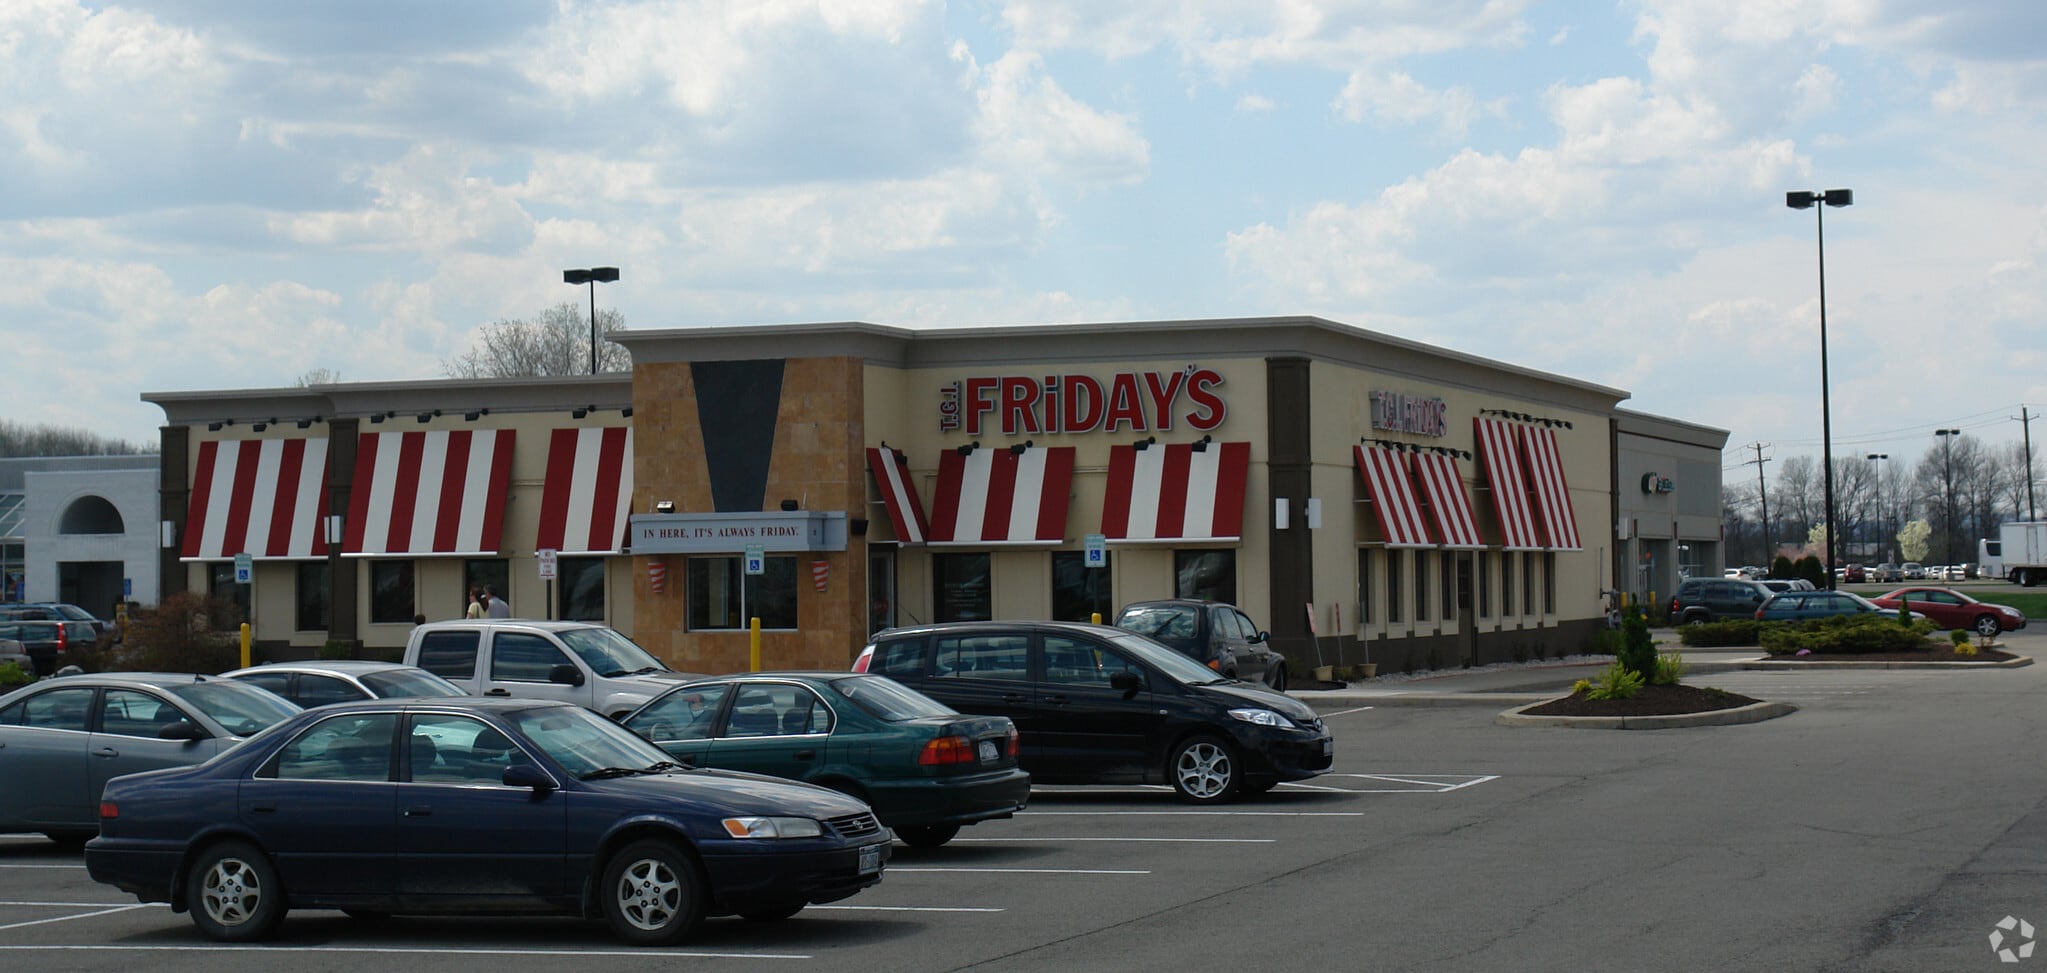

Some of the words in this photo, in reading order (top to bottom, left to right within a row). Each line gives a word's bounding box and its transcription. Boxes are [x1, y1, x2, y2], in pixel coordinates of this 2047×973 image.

[940, 380, 961, 433] T.G.I.
[644, 528, 654, 539] IN
[660, 528, 689, 539] HERE,
[694, 527, 713, 538] IT'S
[718, 527, 755, 537] ALWAYS
[760, 526, 800, 537] FRIDAY.
